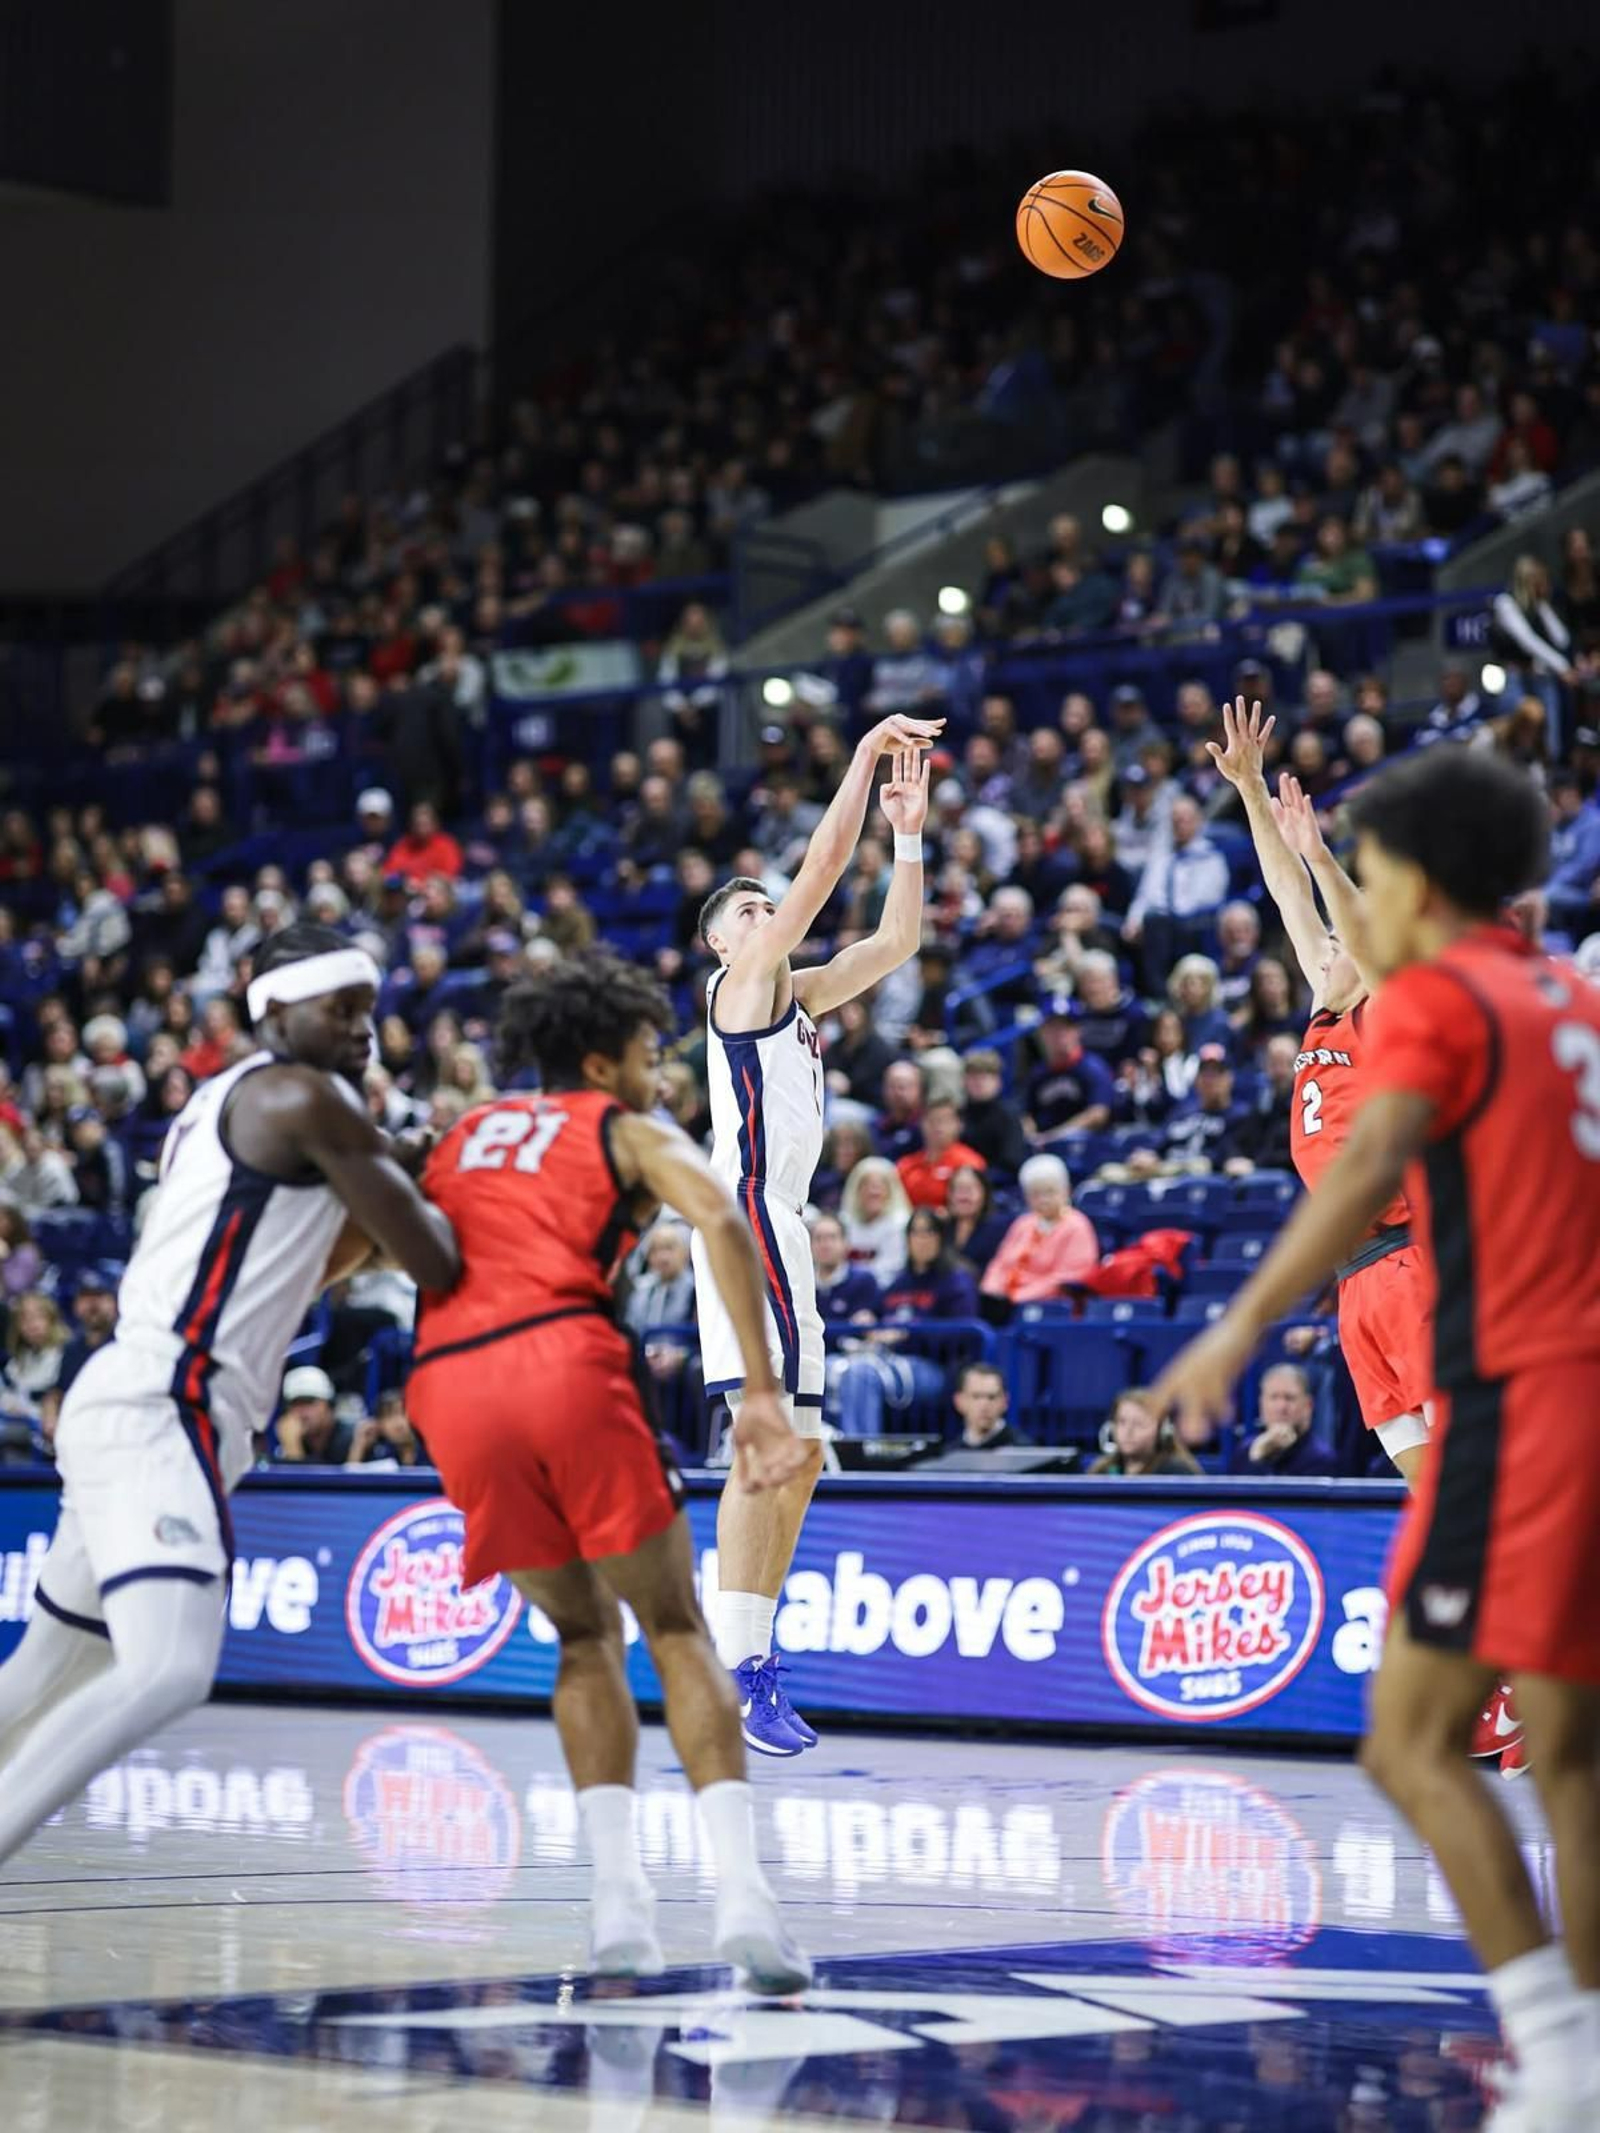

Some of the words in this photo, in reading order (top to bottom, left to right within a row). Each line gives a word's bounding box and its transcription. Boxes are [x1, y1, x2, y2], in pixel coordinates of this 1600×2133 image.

[1302, 1079, 1322, 1135] 2
[457, 1109, 570, 1174] 21
[775, 1551, 1065, 1661] above
[1134, 1559, 1291, 1618] Jersey
